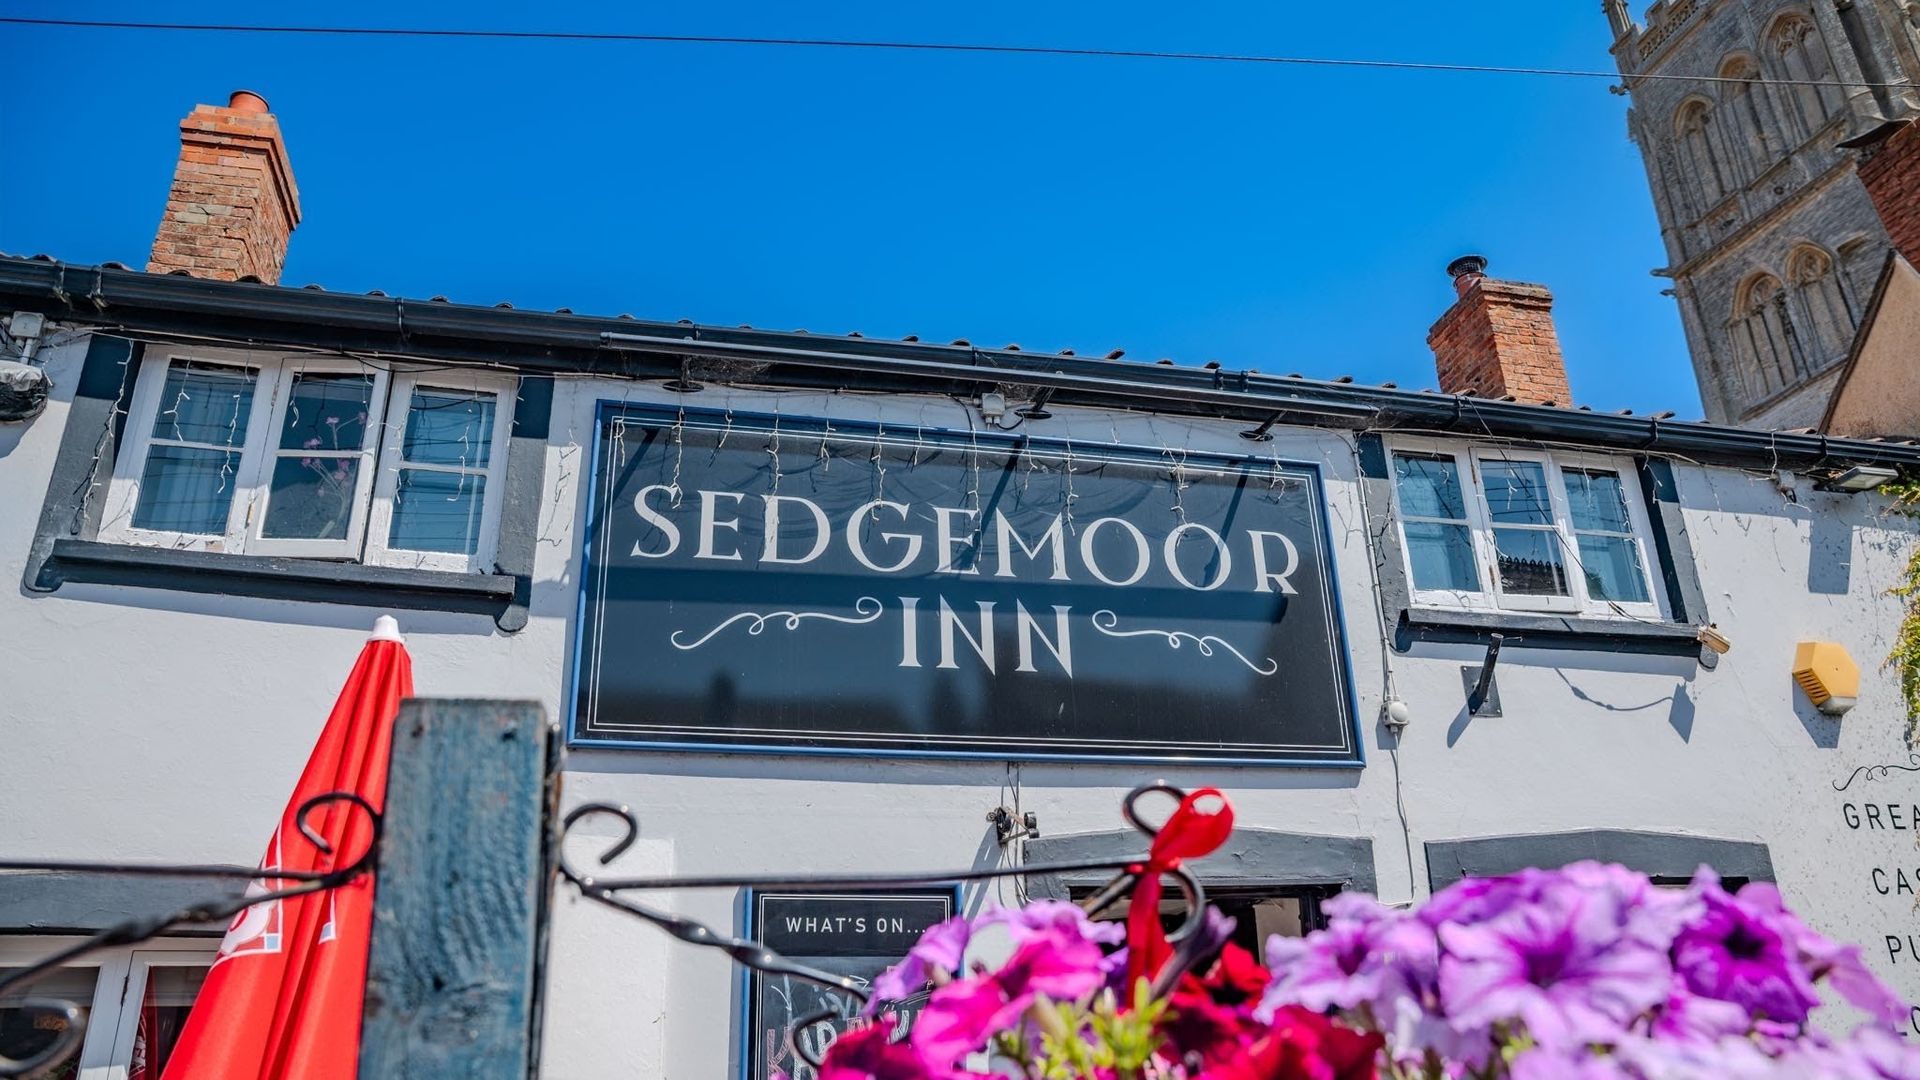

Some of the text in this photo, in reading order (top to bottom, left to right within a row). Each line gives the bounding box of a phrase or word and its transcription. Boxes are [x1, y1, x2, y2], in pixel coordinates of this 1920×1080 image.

[631, 484, 1300, 596] SEDGEMOOR
[897, 596, 1073, 679] INN
[1872, 867, 1920, 895] CA
[786, 917, 867, 933] WHAT'S
